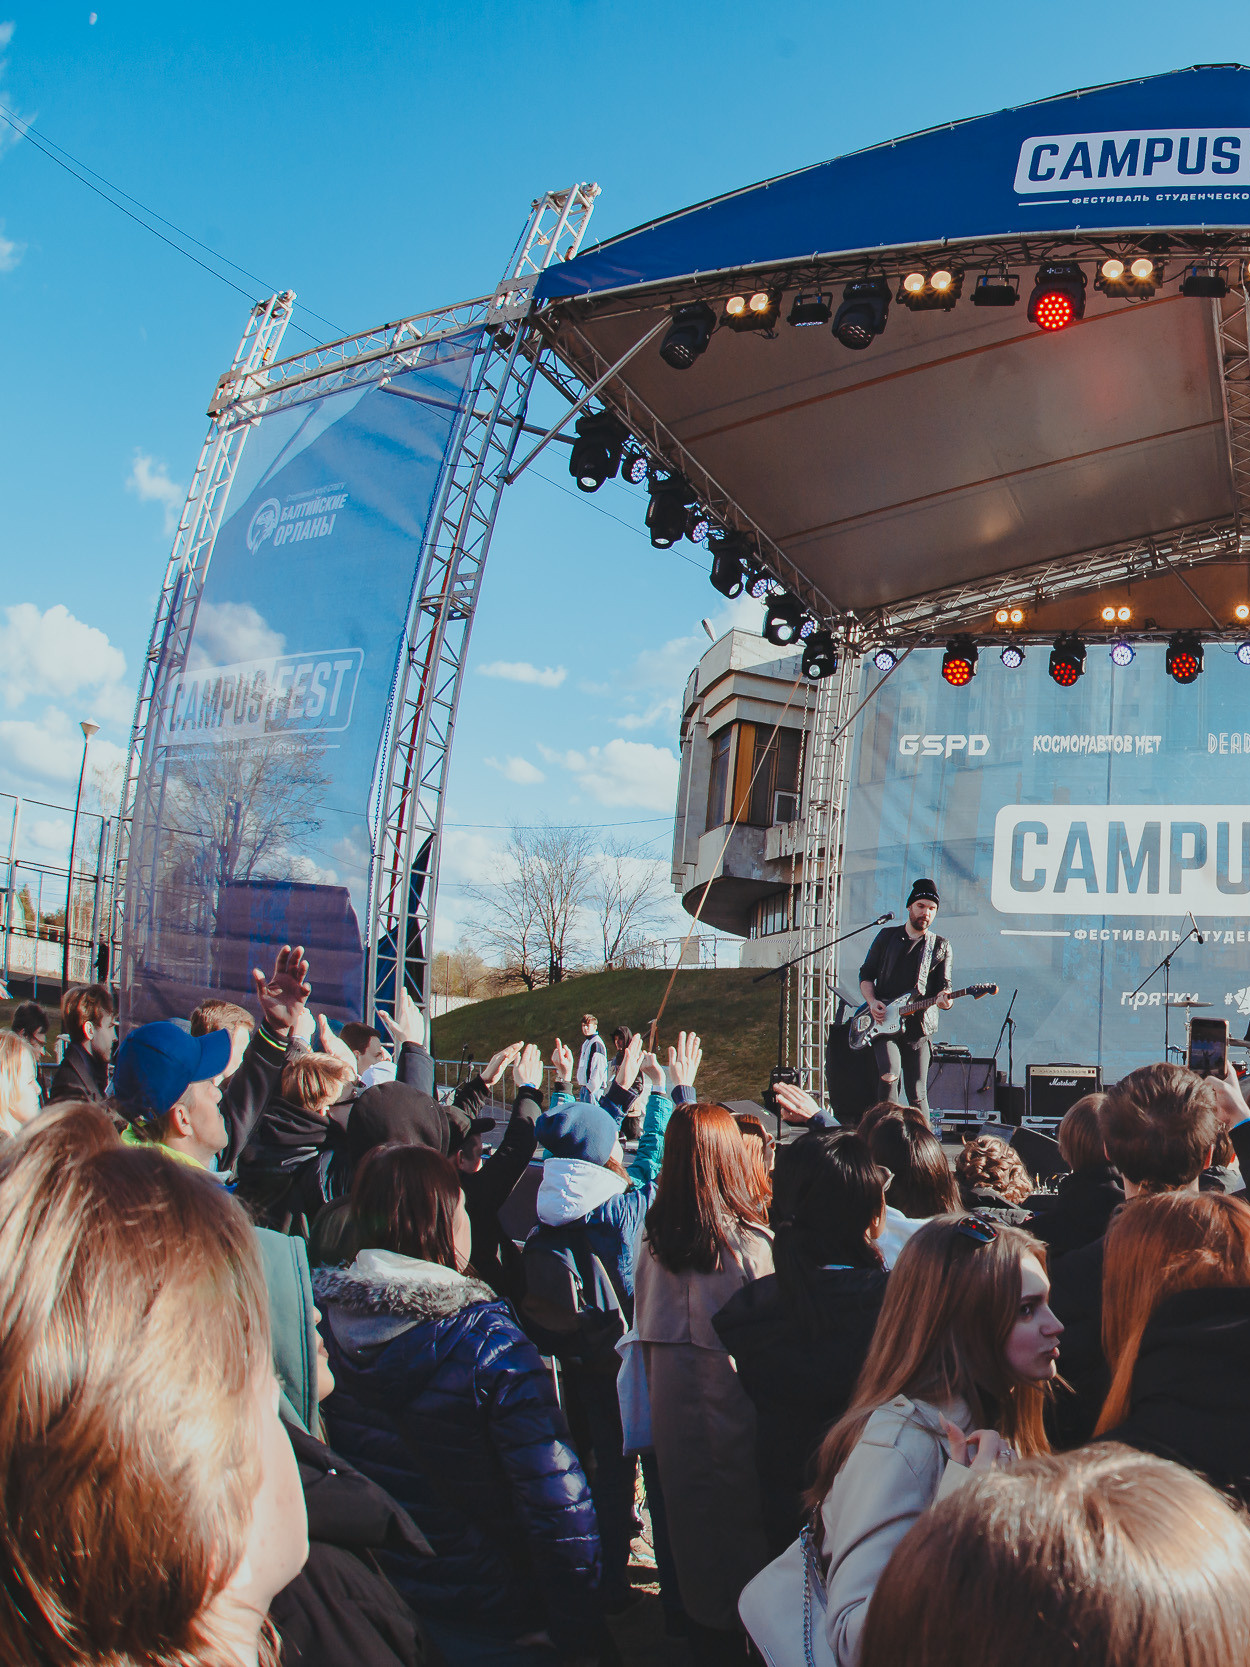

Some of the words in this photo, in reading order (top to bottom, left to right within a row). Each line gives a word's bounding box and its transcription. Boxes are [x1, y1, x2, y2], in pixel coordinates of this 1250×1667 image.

[1028, 136, 1241, 182] CAMPUS
[1071, 194, 1150, 205] ФЕСТИВАЛЬ
[281, 493, 349, 522] БАЛТИЙСКИЕ
[273, 513, 337, 547] ОРЛАНЫ
[170, 669, 266, 732] CAMPUS
[269, 659, 354, 721] FEST
[899, 734, 991, 758] GSPD
[1032, 734, 1132, 757] КОСМОНАВТОВ
[1134, 735, 1162, 757] НЕТ
[1073, 929, 1182, 942] ФЕСТИВАЛЬ
[1049, 1078, 1077, 1086] Marshall
